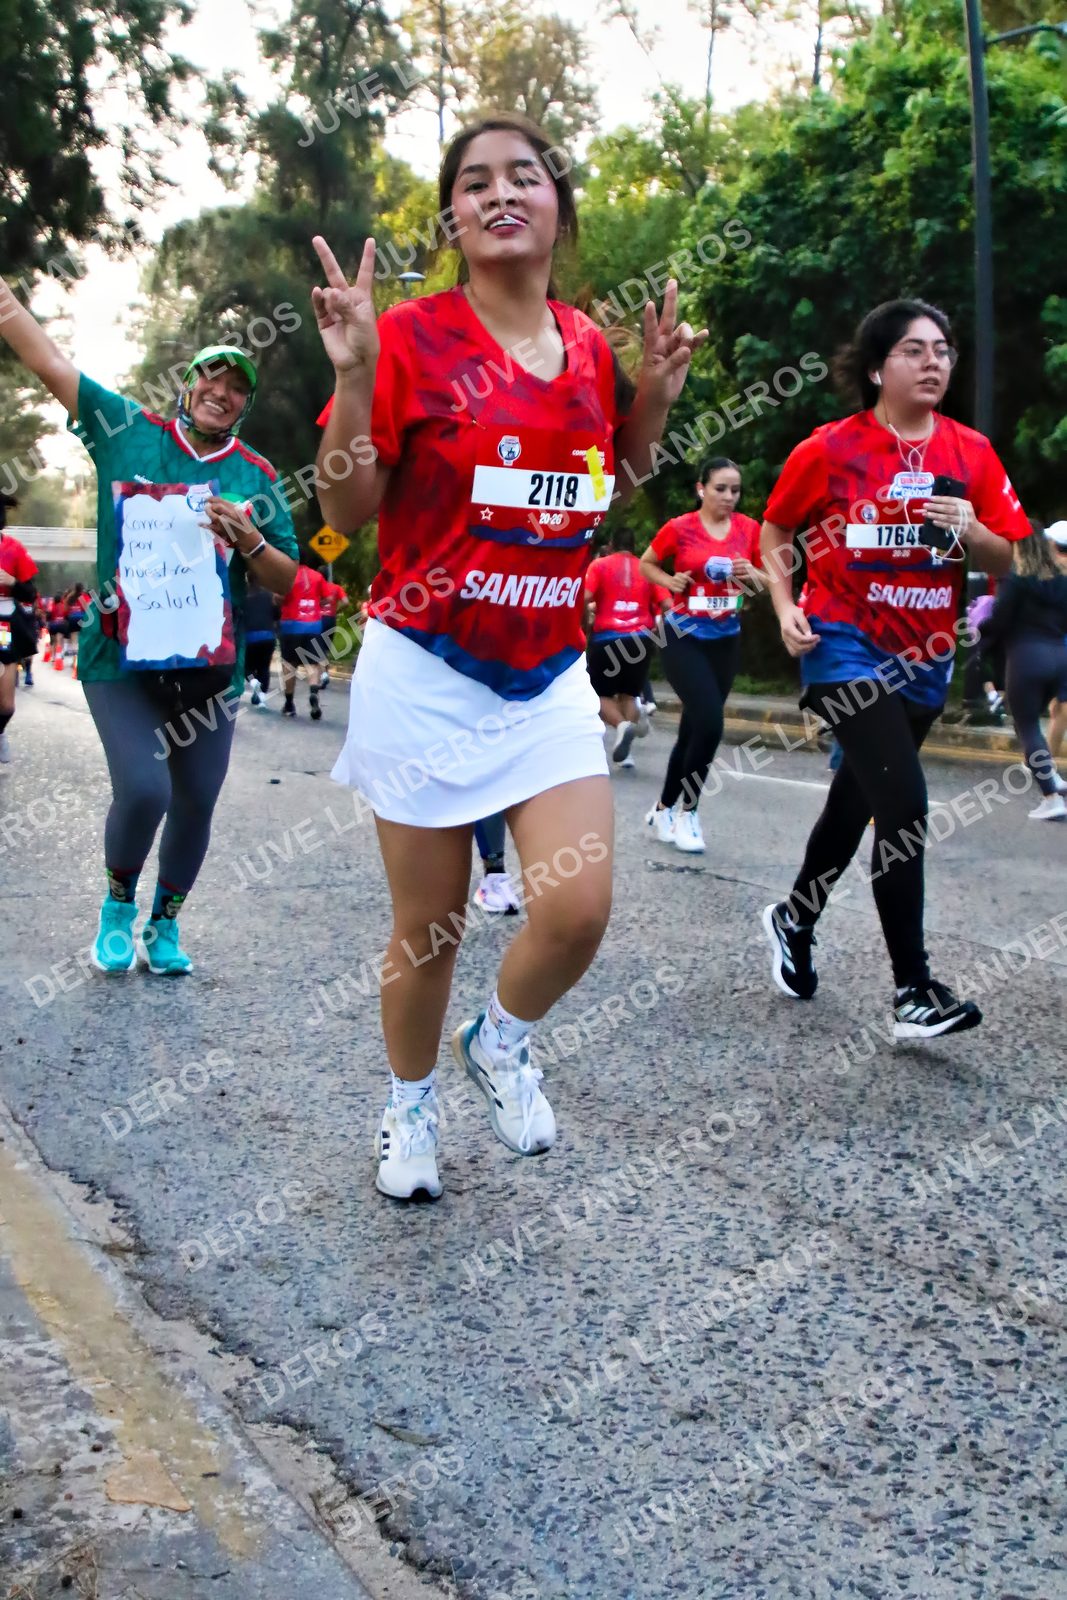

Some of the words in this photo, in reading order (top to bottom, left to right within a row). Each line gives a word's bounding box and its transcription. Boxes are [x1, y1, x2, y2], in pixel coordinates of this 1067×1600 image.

[528, 473, 578, 508] 2118
[877, 526, 922, 547] 1764
[460, 569, 582, 608] SANTIAGO
[867, 582, 952, 610] SANTIAGO
